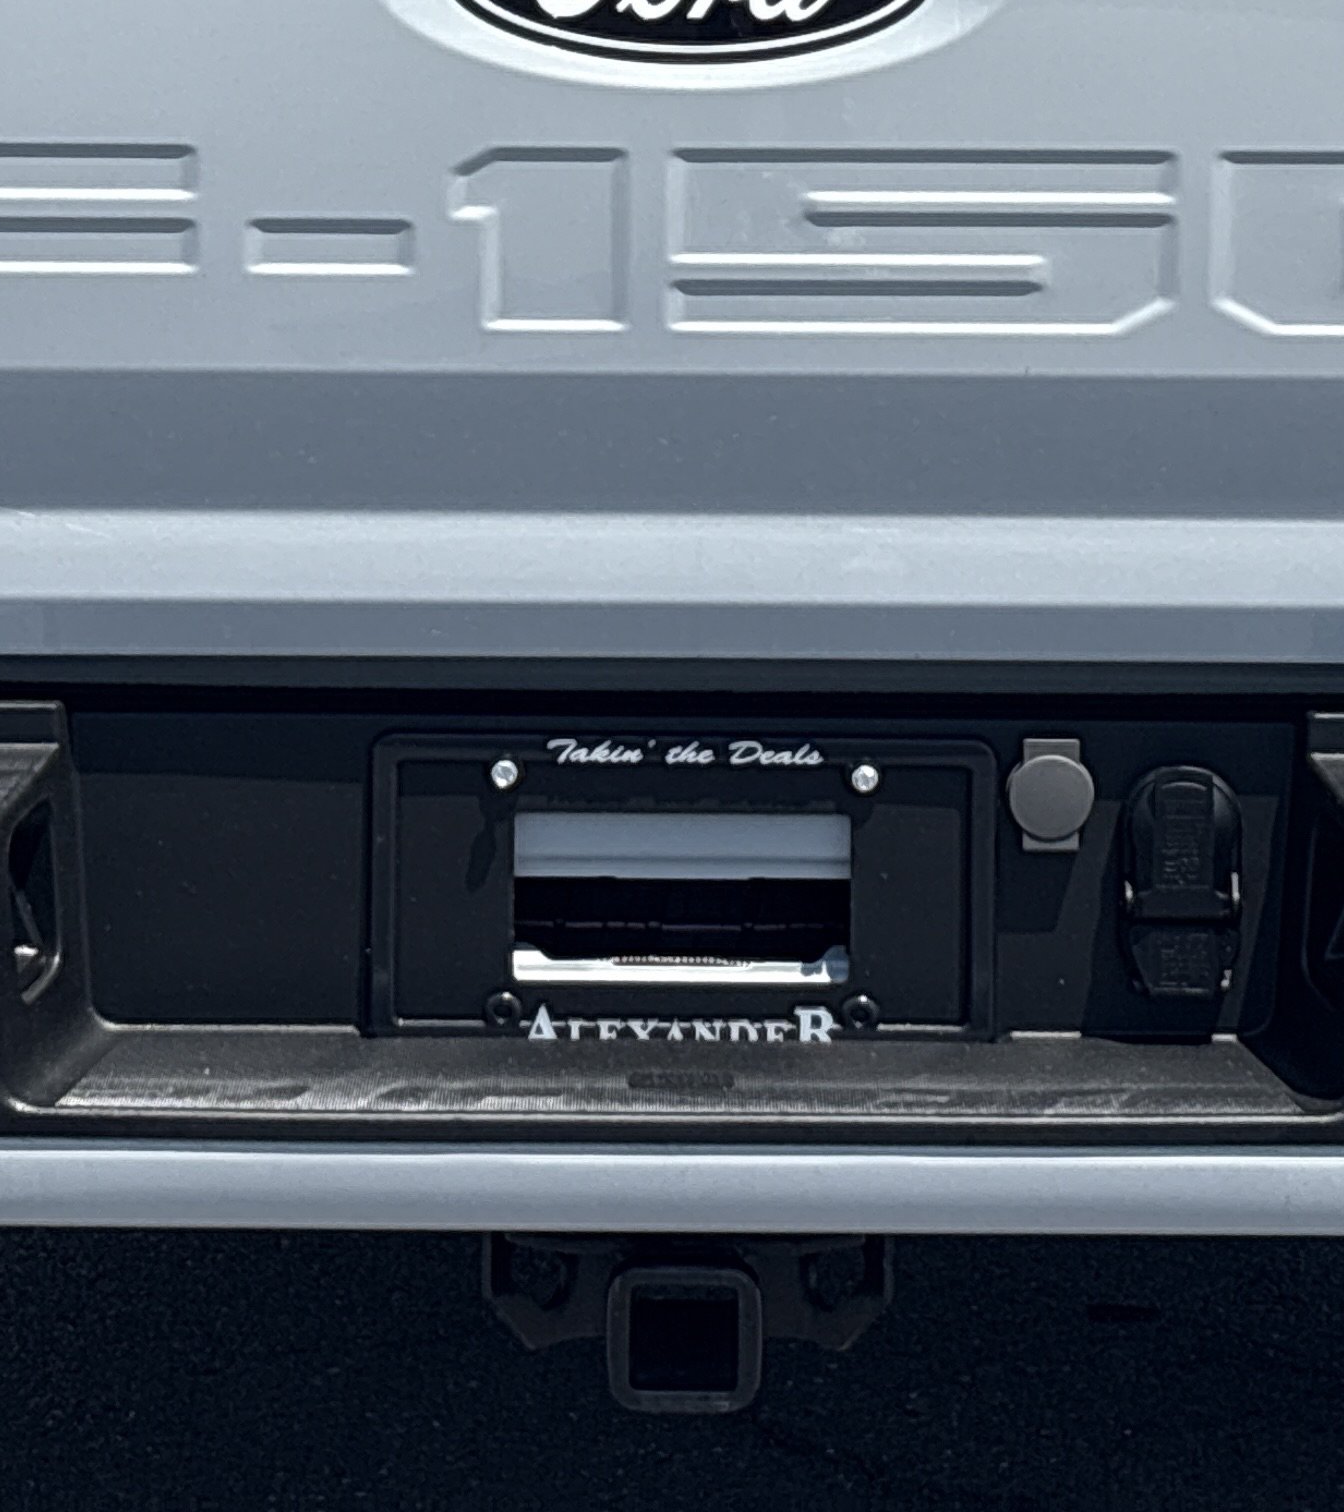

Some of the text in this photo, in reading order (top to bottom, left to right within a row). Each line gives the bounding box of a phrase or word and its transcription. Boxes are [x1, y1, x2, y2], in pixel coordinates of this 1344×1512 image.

[547, 738, 824, 765] Takin' the Deals
